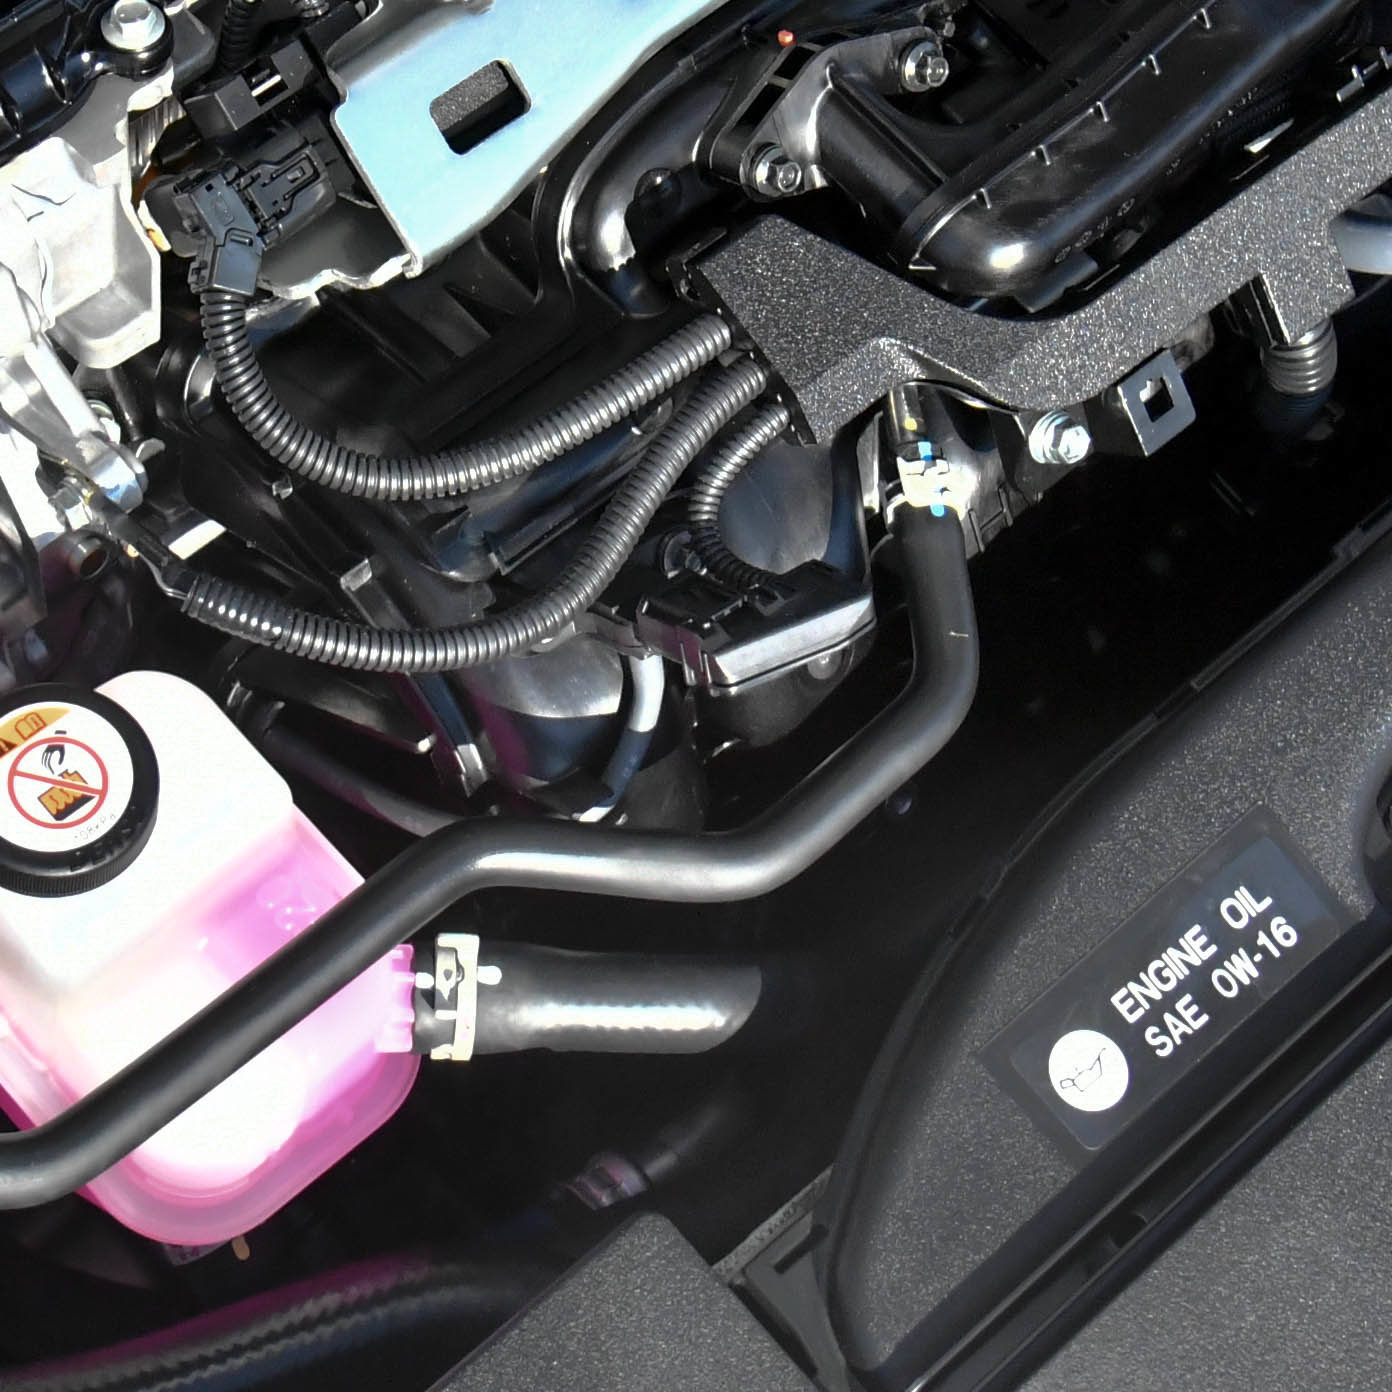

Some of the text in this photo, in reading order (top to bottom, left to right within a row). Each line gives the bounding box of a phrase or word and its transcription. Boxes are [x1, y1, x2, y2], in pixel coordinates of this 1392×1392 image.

[1110, 885, 1273, 1024] ENGINE OIL
[1144, 916, 1298, 1057] SAE 0W-16
